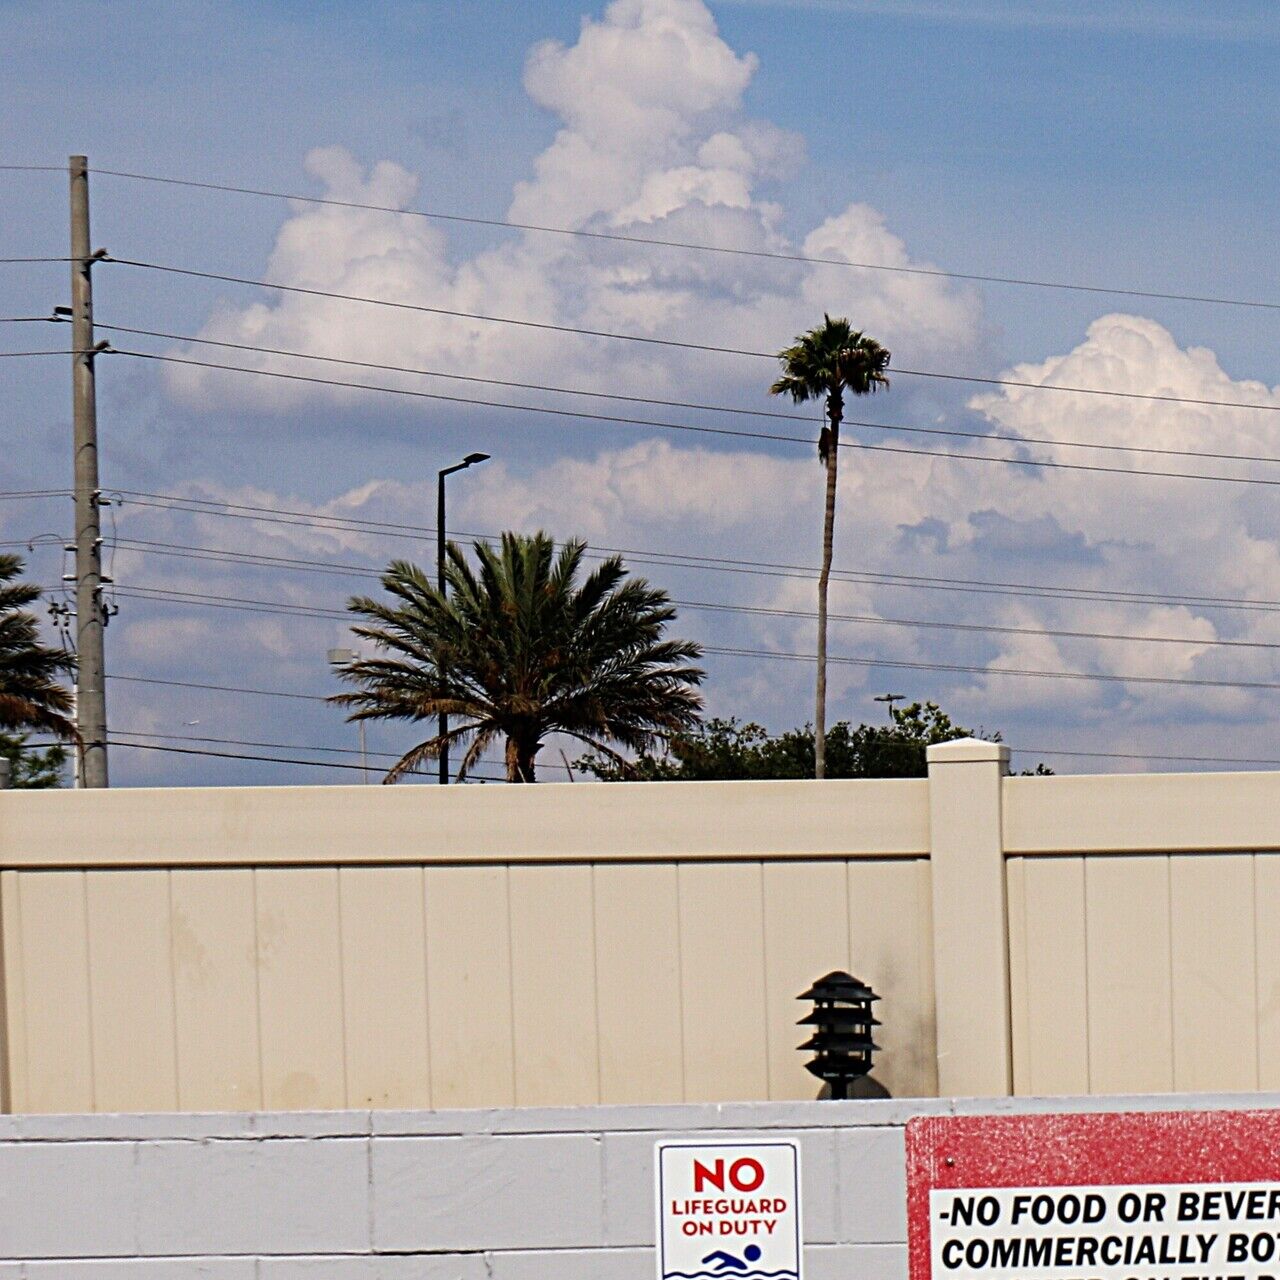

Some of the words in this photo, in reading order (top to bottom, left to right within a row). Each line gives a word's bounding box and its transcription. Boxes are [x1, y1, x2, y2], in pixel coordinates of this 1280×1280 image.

[694, 1157, 765, 1193] NO
[672, 1198, 787, 1215] LIFEGUARD
[940, 1196, 1000, 1226] -NO
[1012, 1195, 1106, 1225] FOOD
[1118, 1193, 1166, 1222] OR
[682, 1221, 713, 1236] ON
[719, 1219, 777, 1235] DUTY
[942, 1234, 1217, 1269] COMMERCIALLY
